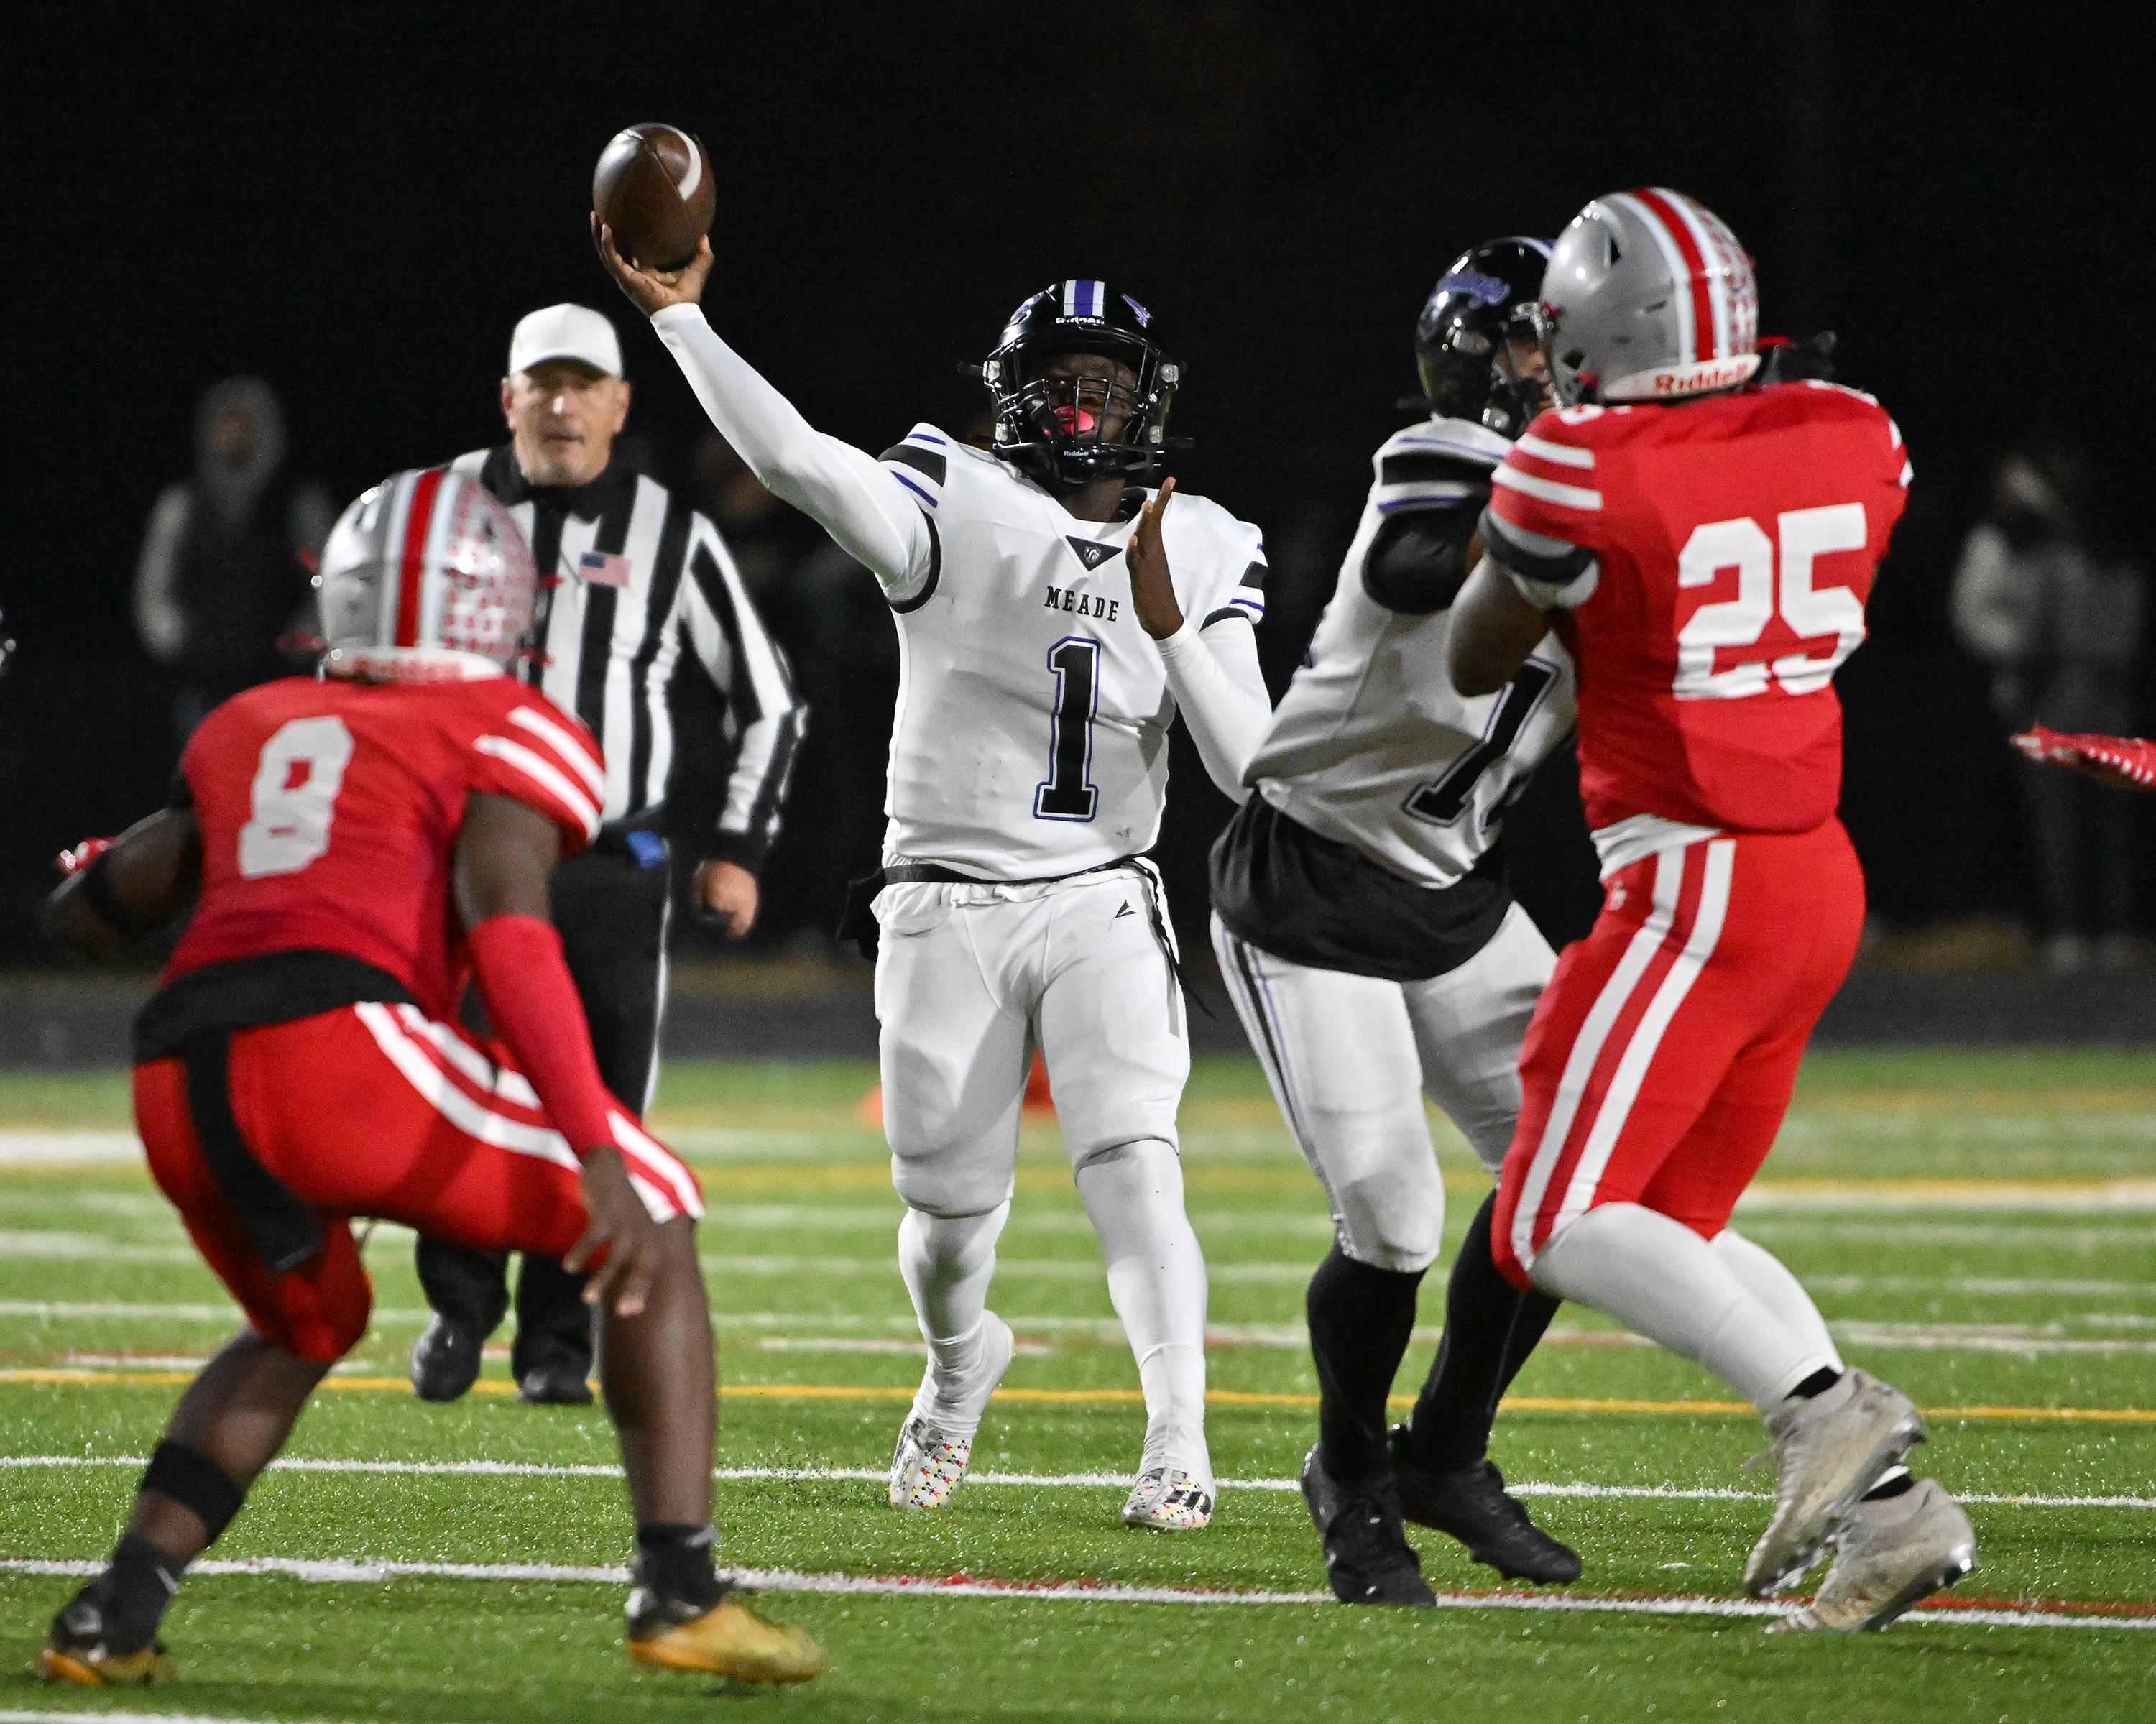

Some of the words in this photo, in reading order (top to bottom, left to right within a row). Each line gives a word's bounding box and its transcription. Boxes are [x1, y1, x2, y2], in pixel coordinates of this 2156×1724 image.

[1044, 586, 1119, 622] MEADE
[1672, 502, 1867, 700] 25
[237, 714, 356, 880] 8
[1033, 636, 1101, 822] 1
[1401, 654, 1563, 834] 1
